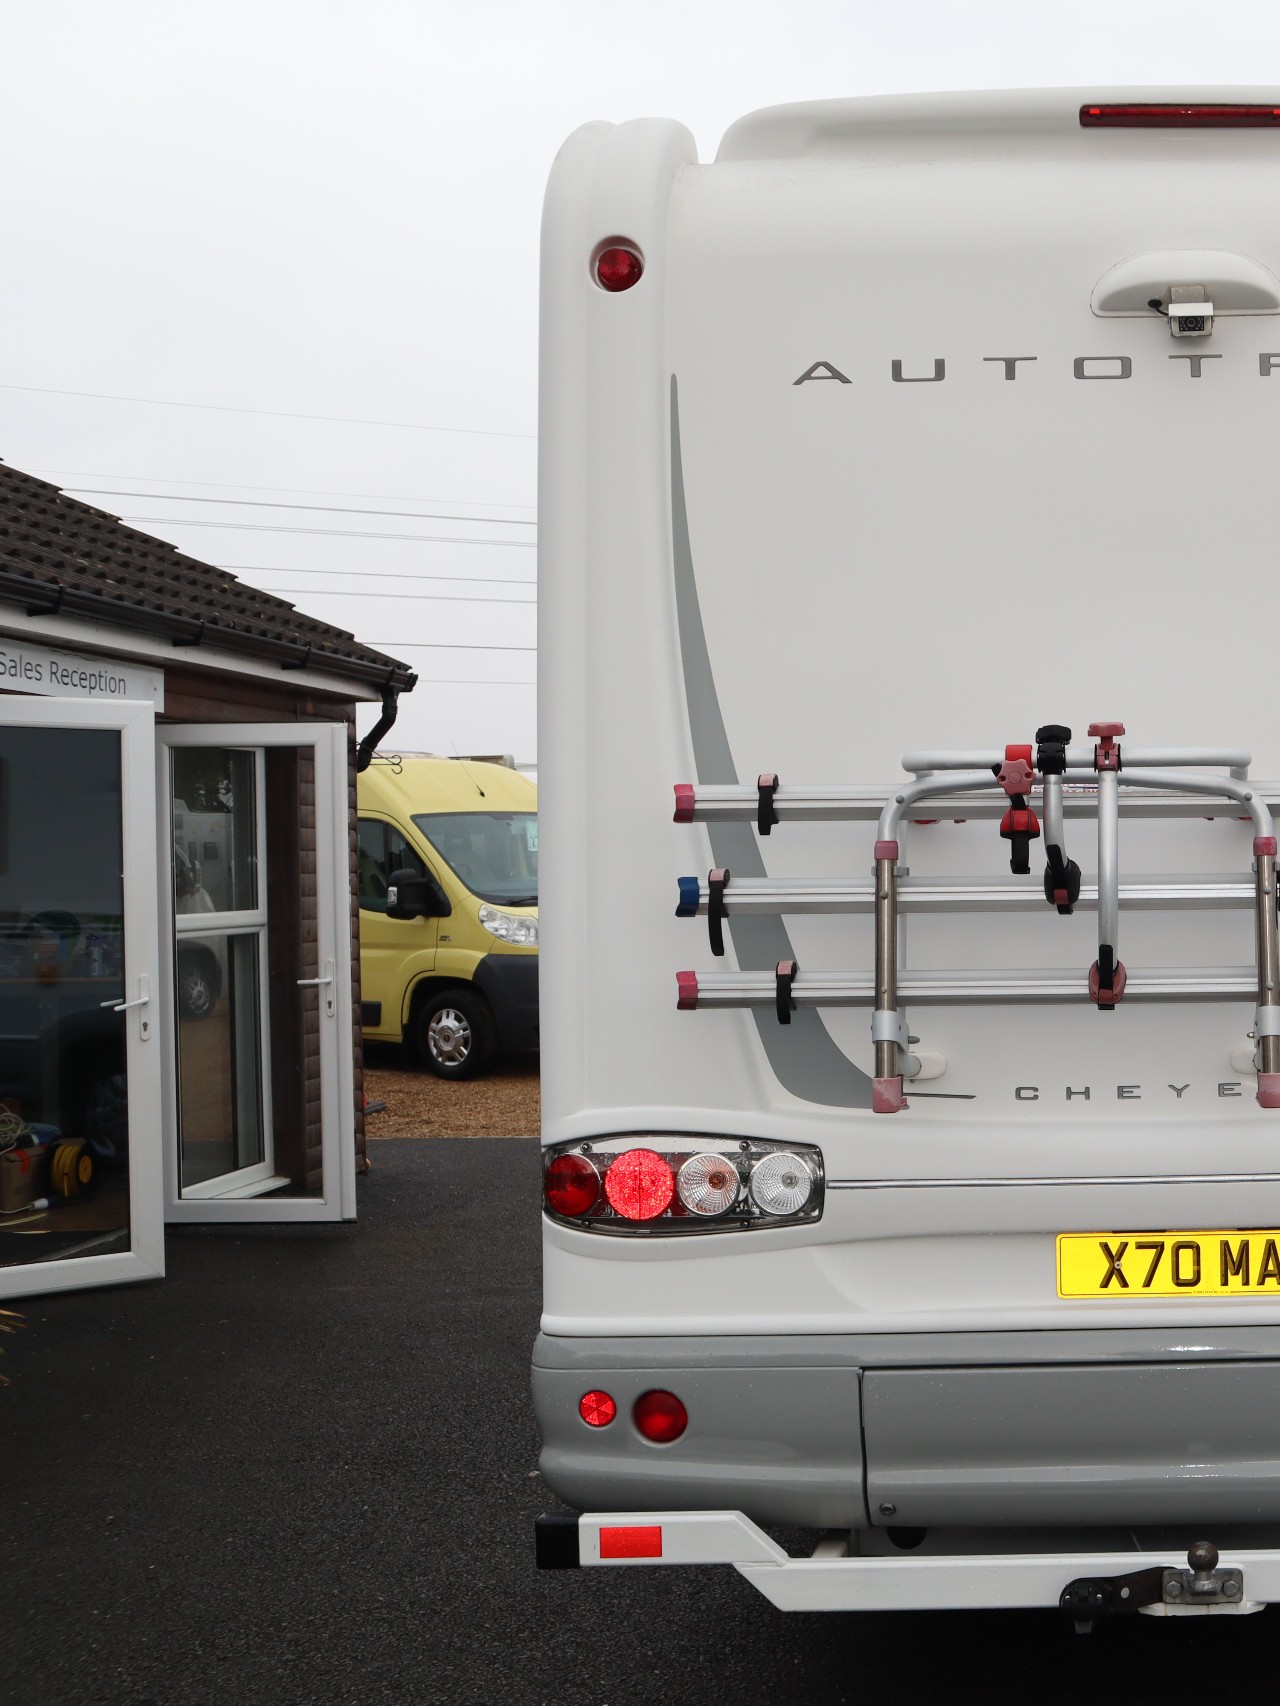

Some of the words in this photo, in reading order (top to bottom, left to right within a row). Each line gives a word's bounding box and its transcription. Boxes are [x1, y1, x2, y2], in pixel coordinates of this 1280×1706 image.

[0, 651, 43, 682] Sales
[50, 660, 127, 695] Reception
[1099, 1240, 1201, 1289] X70
